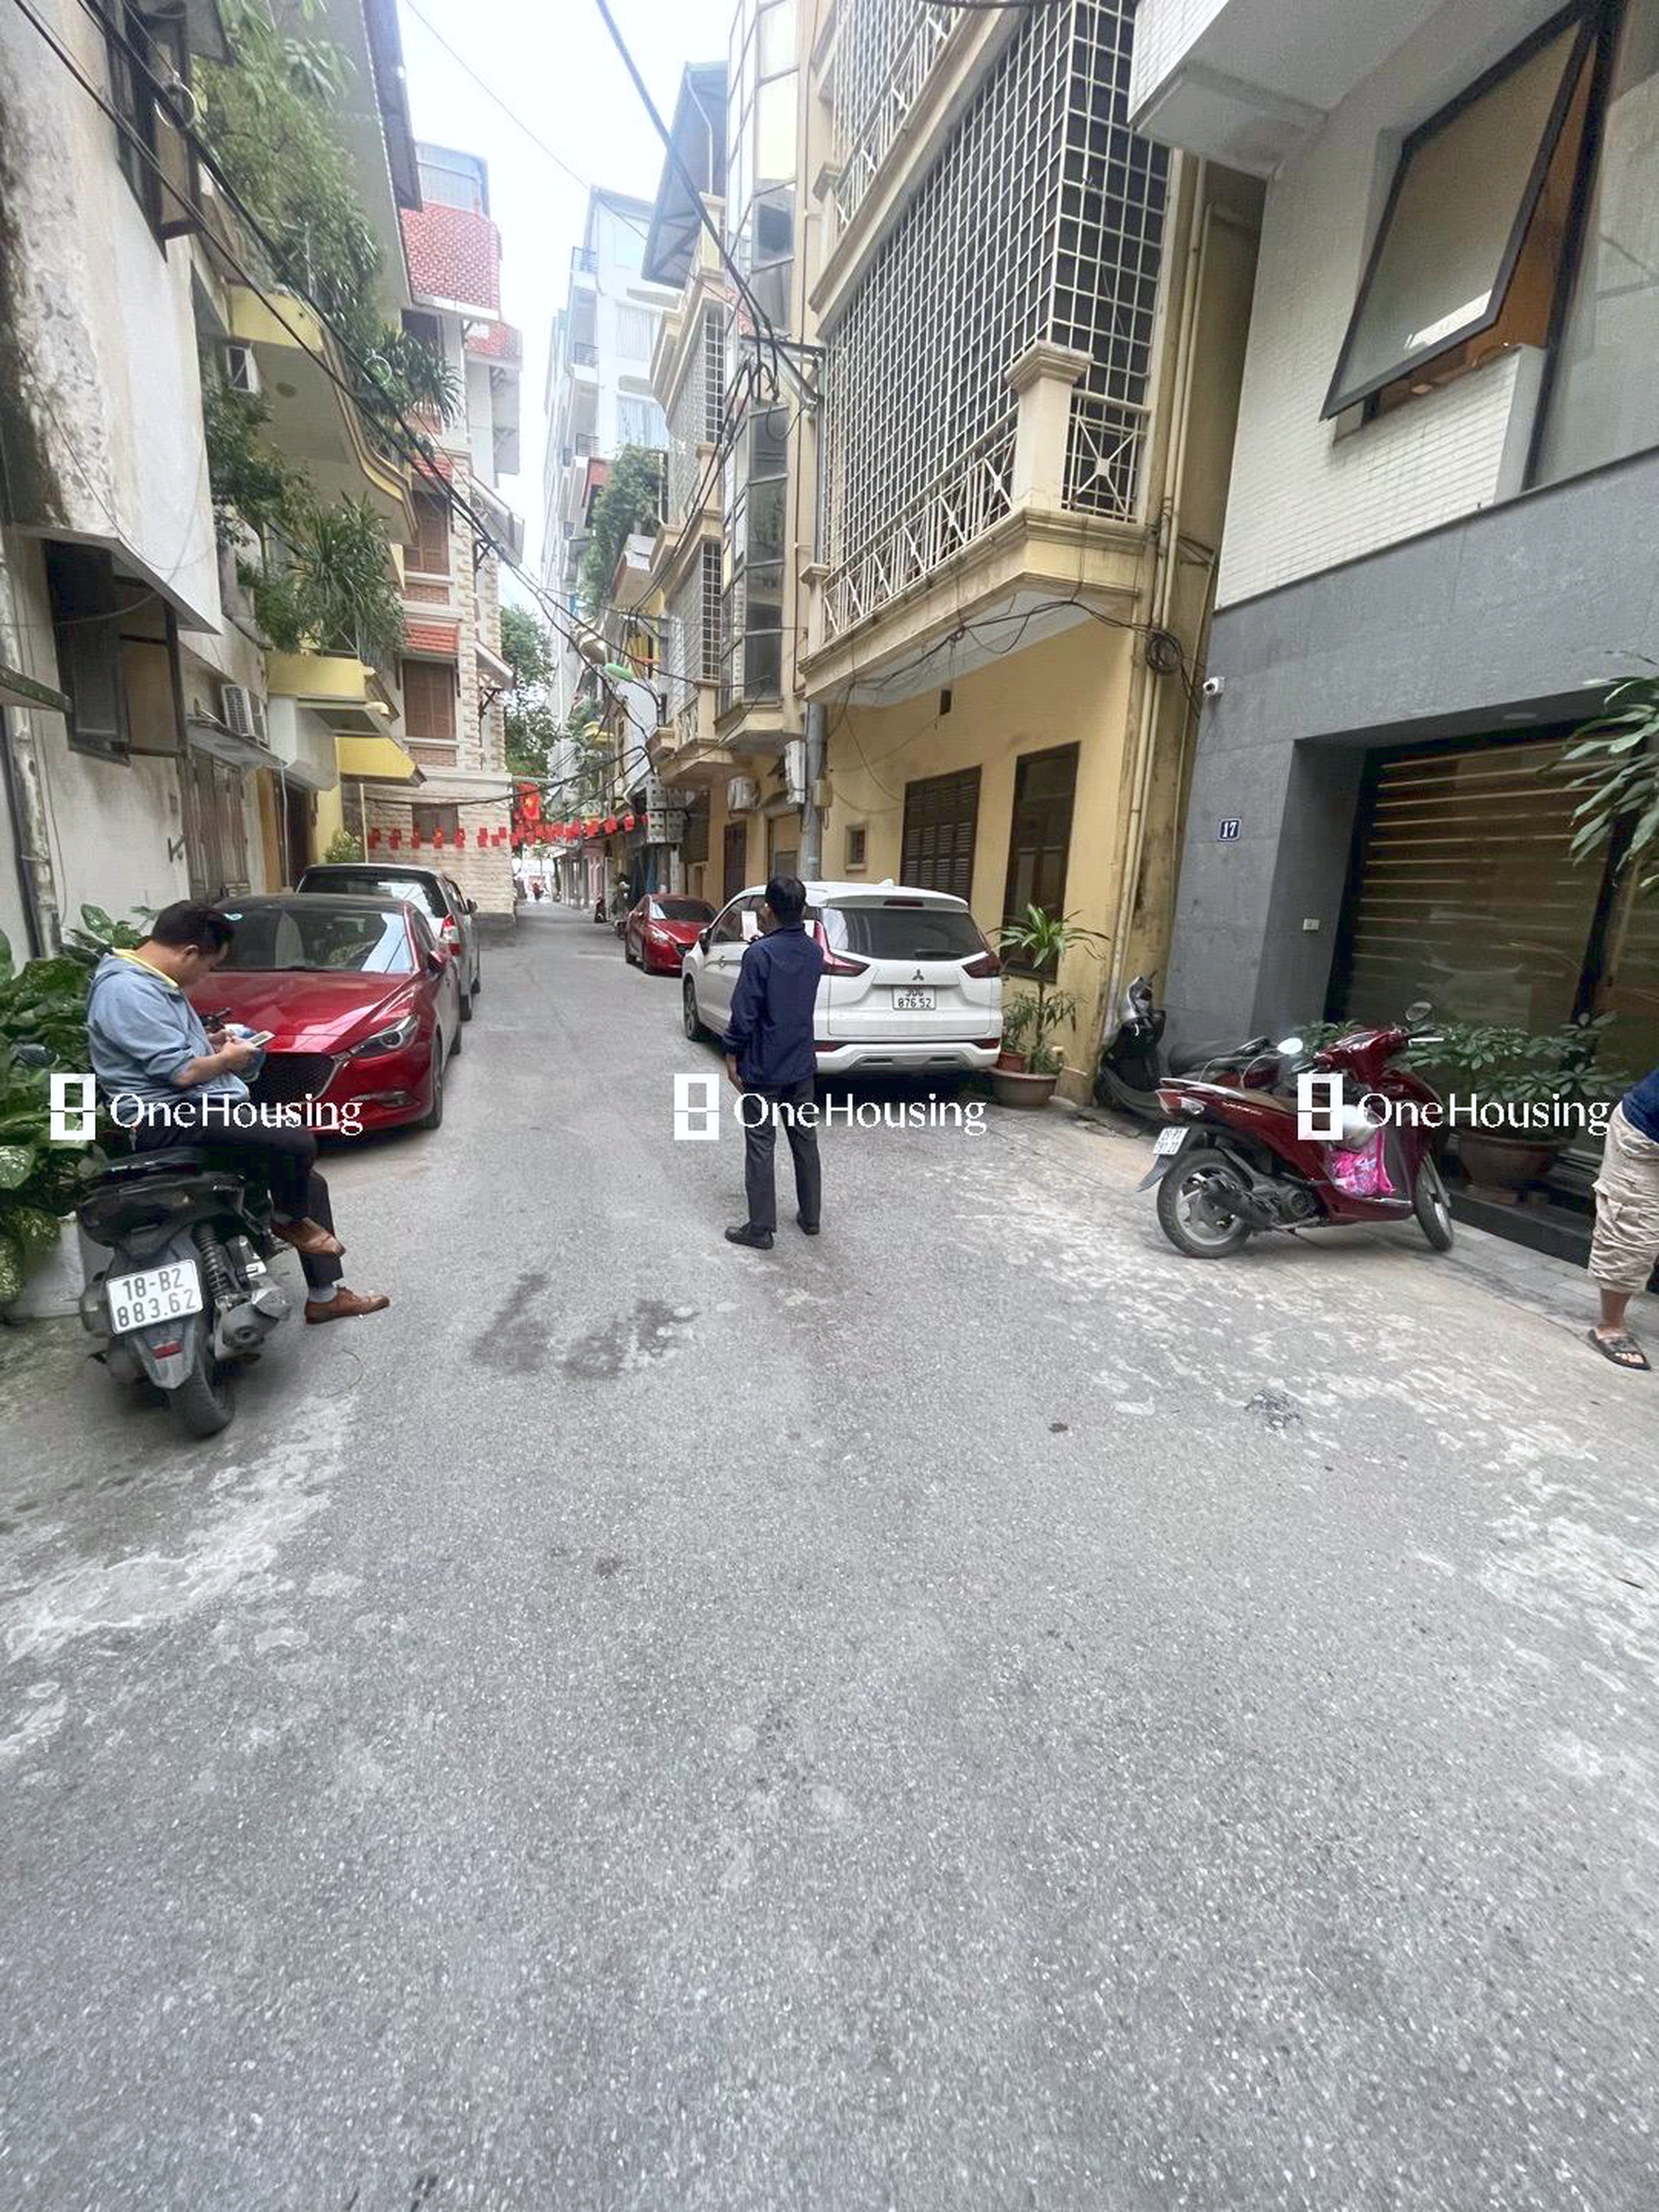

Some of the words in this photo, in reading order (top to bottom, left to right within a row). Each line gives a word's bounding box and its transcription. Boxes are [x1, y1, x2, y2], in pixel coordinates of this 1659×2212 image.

[1222, 821, 1238, 838] 17
[122, 1267, 184, 1302] 18-B2
[117, 1288, 196, 1328] 883.62
